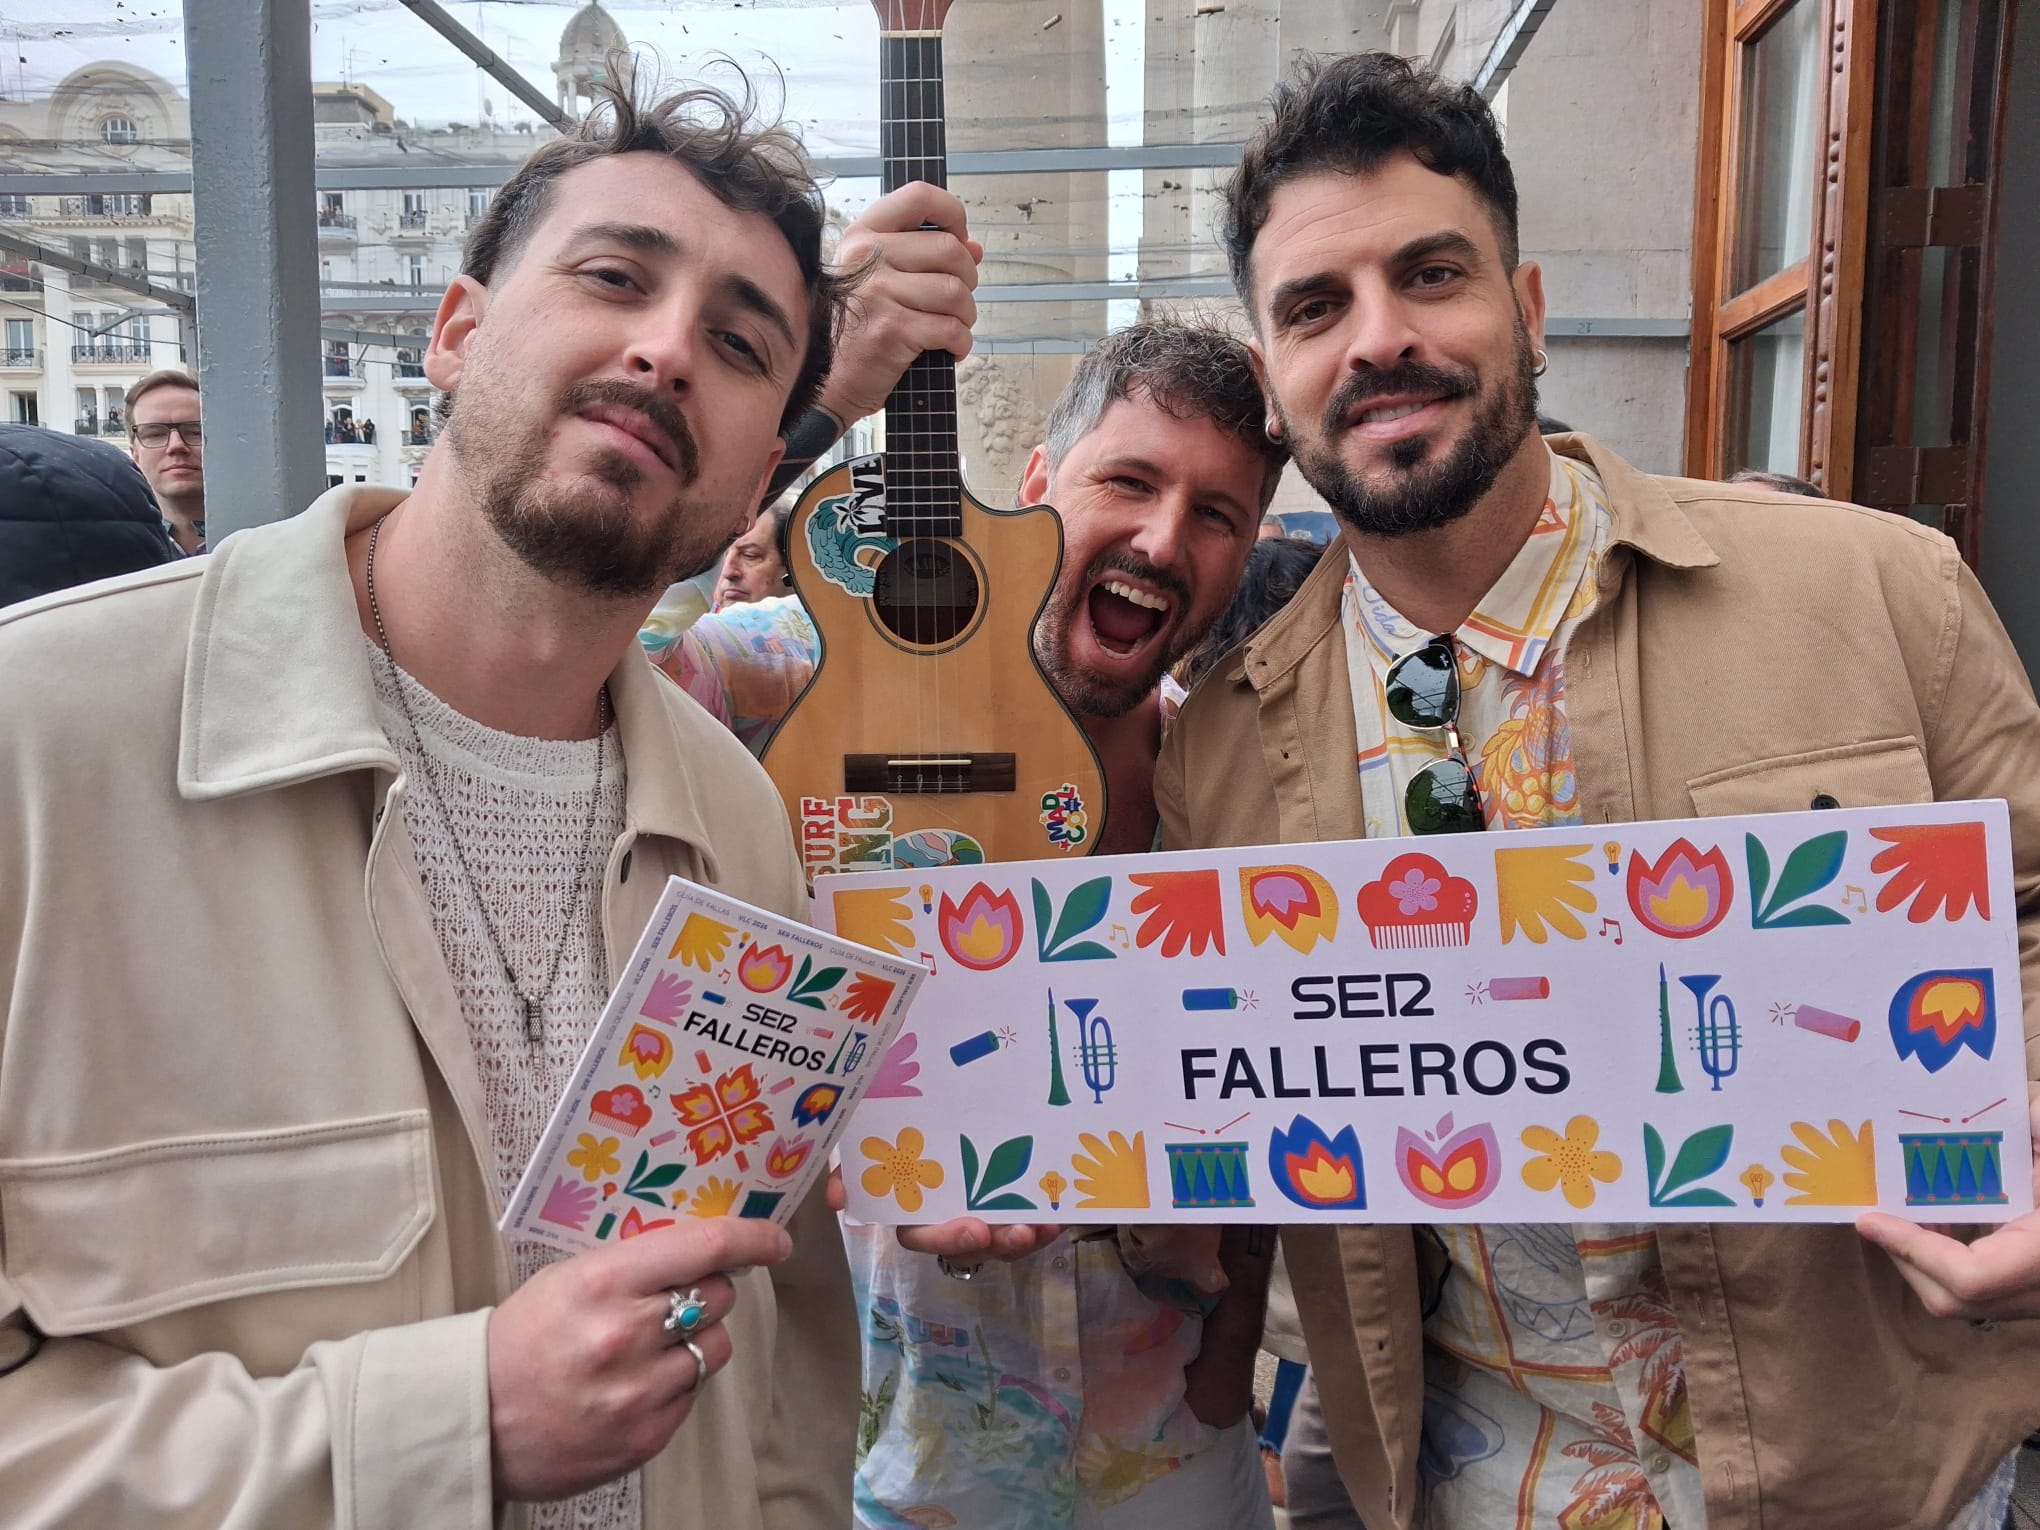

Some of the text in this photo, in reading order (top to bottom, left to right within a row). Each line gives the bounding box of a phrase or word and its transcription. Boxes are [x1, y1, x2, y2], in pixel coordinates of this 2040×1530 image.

[838, 799, 891, 874] NG
[1042, 794, 1067, 841] MAD
[742, 1003, 798, 1034] SER
[1291, 972, 1434, 1020] SER
[683, 1010, 826, 1071] FALLEROS
[1181, 1038, 1571, 1100] FALLEROS
